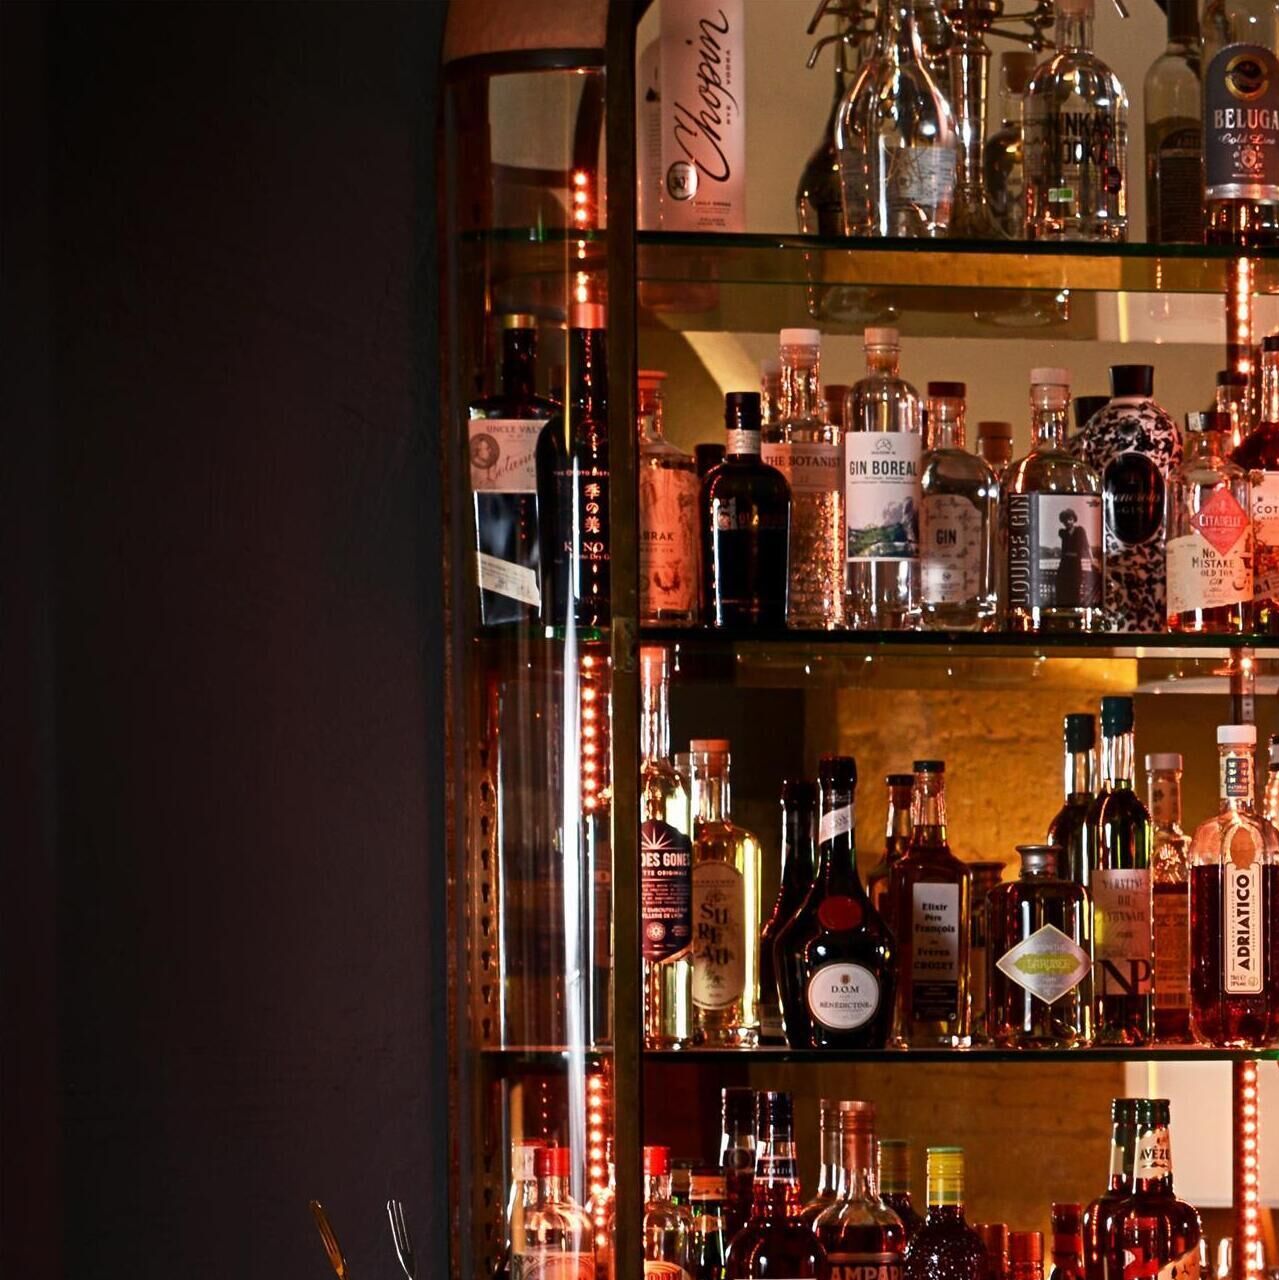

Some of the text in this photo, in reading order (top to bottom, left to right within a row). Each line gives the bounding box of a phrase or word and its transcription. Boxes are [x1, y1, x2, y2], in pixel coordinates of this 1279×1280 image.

[674, 9, 740, 182] Chopin
[1213, 108, 1279, 130] BELUGA
[765, 455, 841, 468] THE BOTANIST
[849, 460, 918, 477] GIN BOREAL
[935, 528, 957, 545] GIN
[1010, 493, 1031, 605] LOUISE GIN
[1202, 548, 1216, 559] No
[1191, 556, 1235, 569] MISTAKE
[921, 902, 949, 912] Elixir
[914, 924, 956, 935] François
[1236, 873, 1251, 971] ADRIATICO
[830, 985, 860, 994] D.O.M
